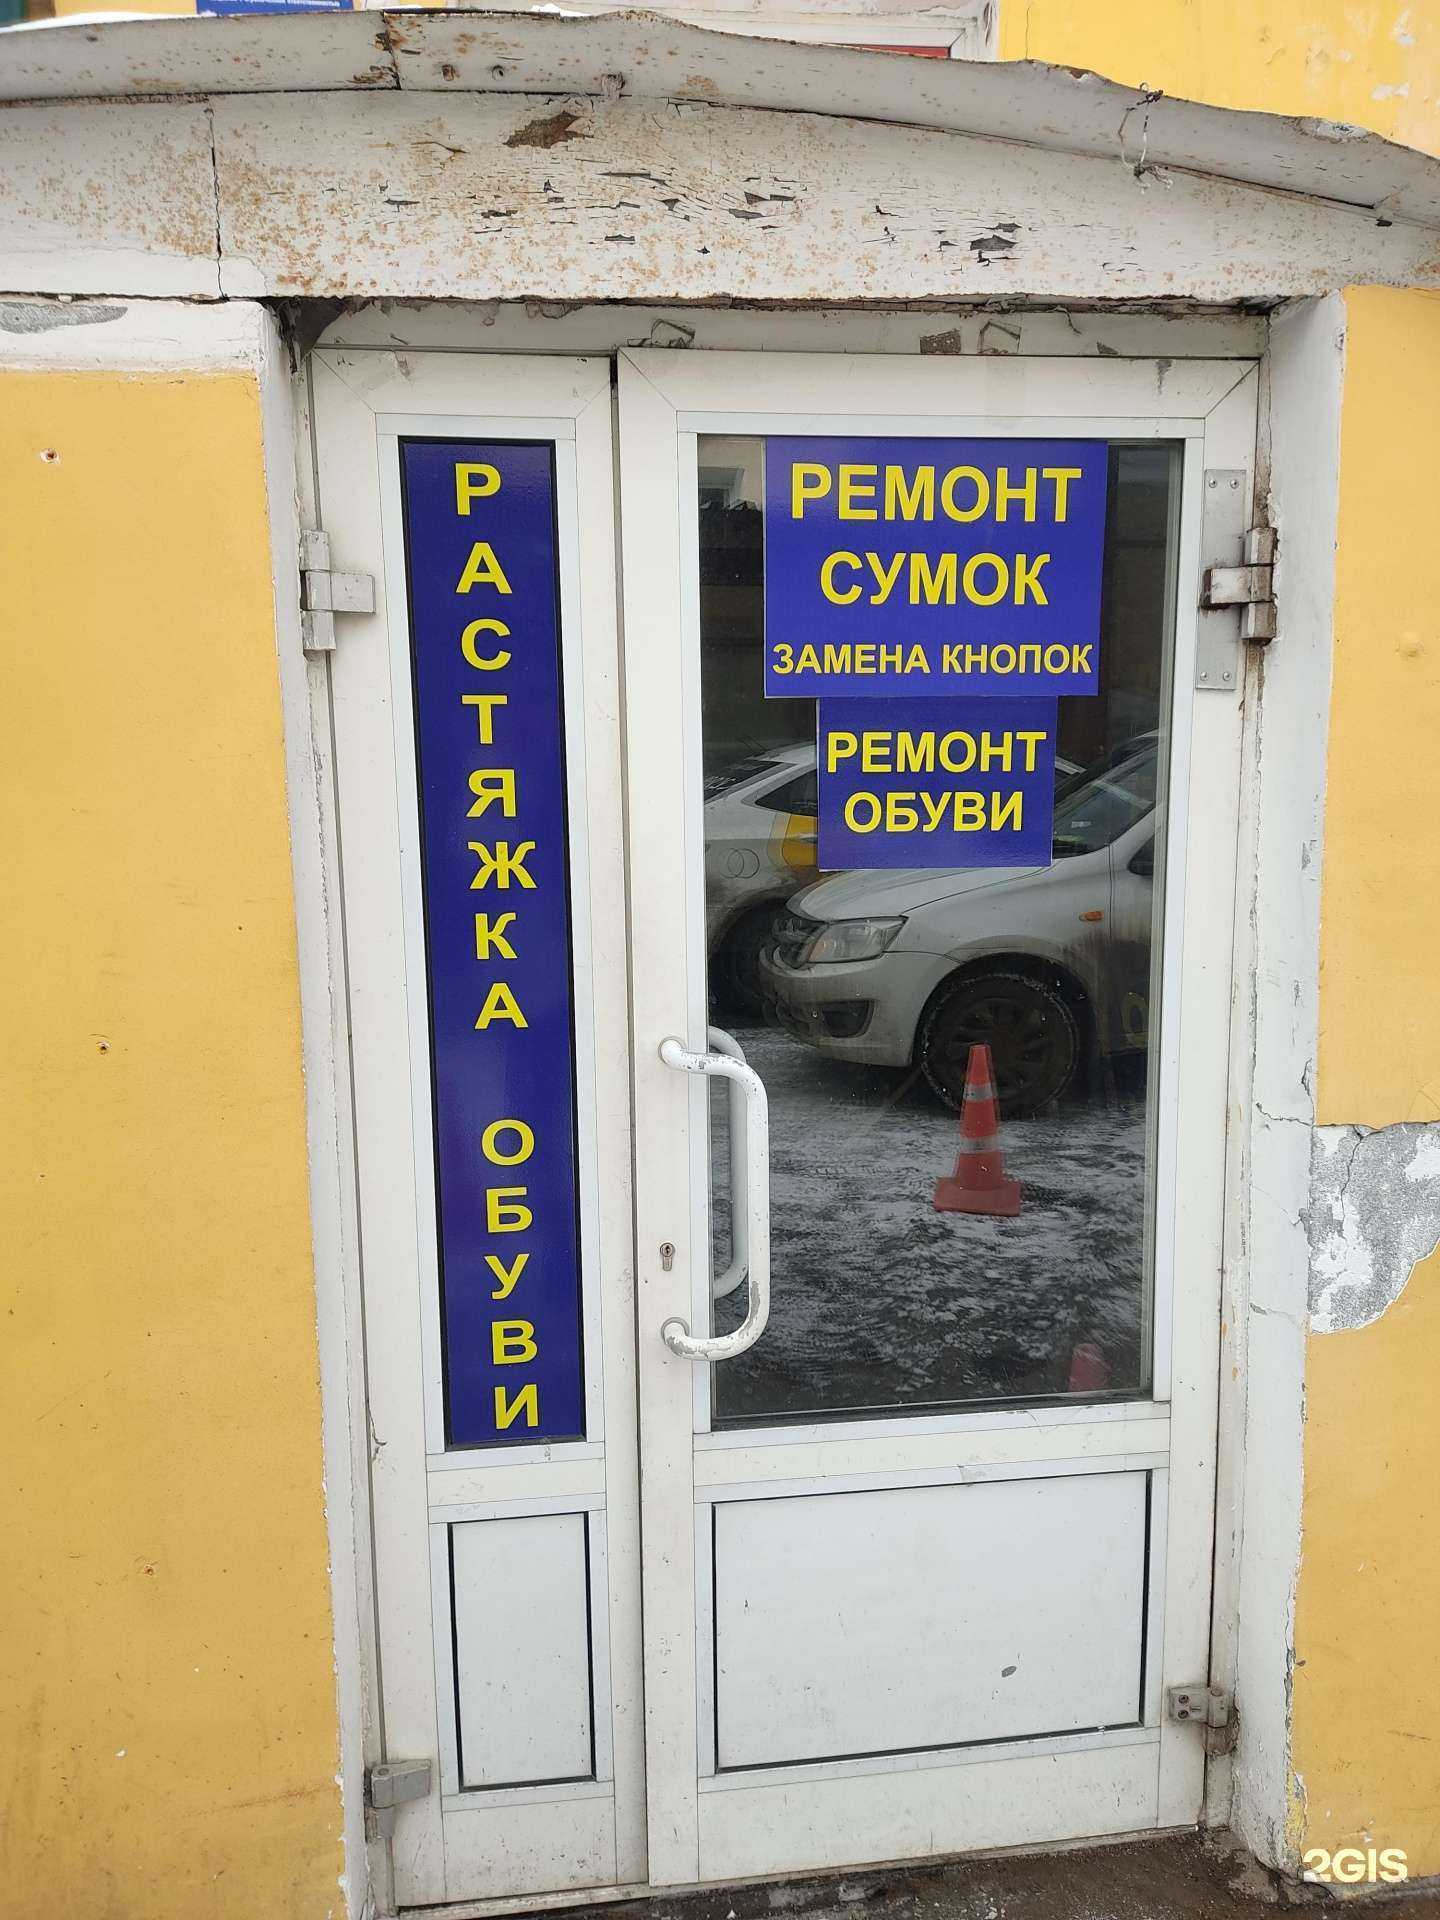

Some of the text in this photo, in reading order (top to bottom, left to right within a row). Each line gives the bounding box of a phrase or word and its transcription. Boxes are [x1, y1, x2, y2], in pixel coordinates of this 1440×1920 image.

[790, 462, 1083, 524] РЕМОНТ
[819, 550, 1052, 607] СУМОК
[772, 642, 1092, 675] ЗАМЕНА КНОПОК
[826, 730, 1048, 774] РЕМОНТ
[843, 790, 1025, 834] ОБУВИ
[454, 461, 540, 1431] РАСТЯЖКА ОБУВИ
